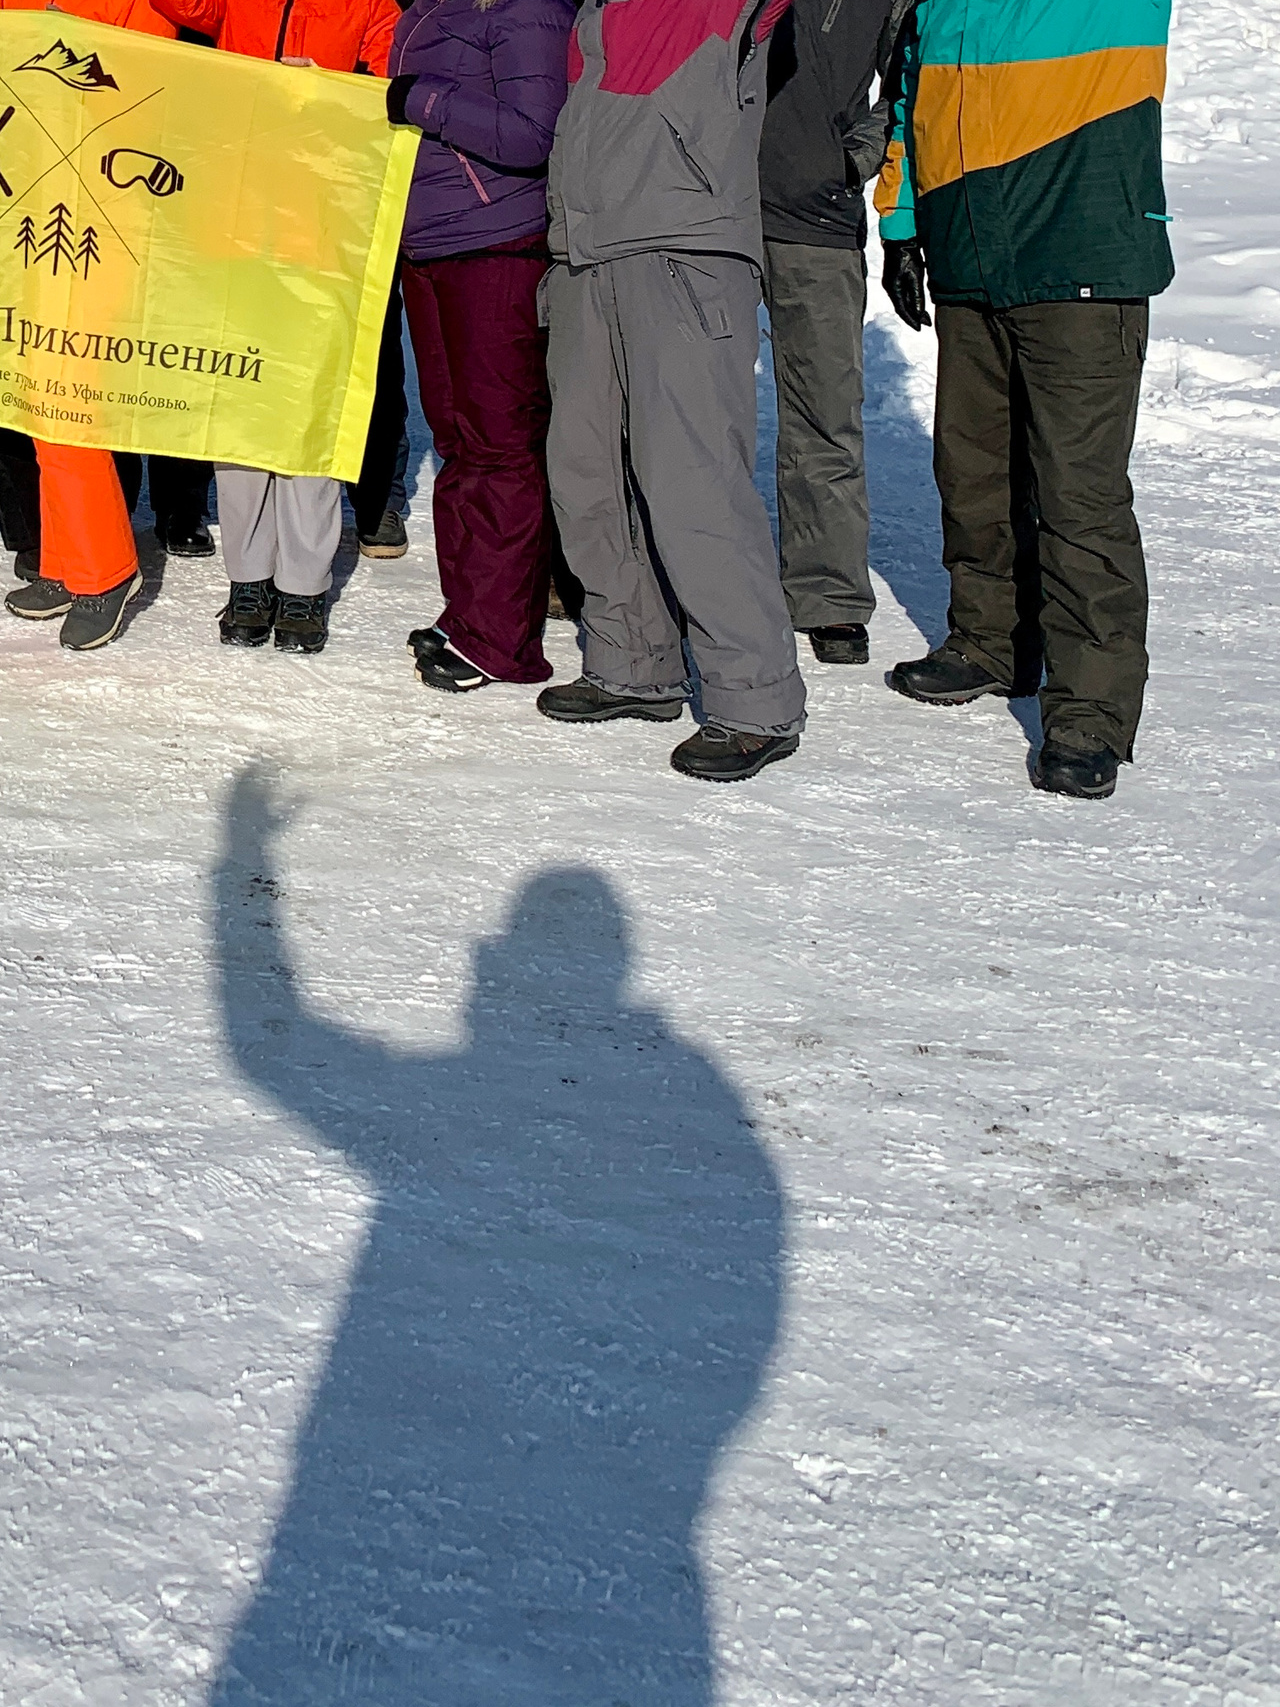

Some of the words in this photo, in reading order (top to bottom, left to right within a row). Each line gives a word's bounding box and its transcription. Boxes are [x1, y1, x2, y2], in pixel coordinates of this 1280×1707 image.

[1, 391, 94, 426] @snowskitours
[44, 378, 67, 397] Из
[72, 382, 104, 405] Уфы
[107, 391, 115, 403] с
[117, 390, 192, 412] любовью.
